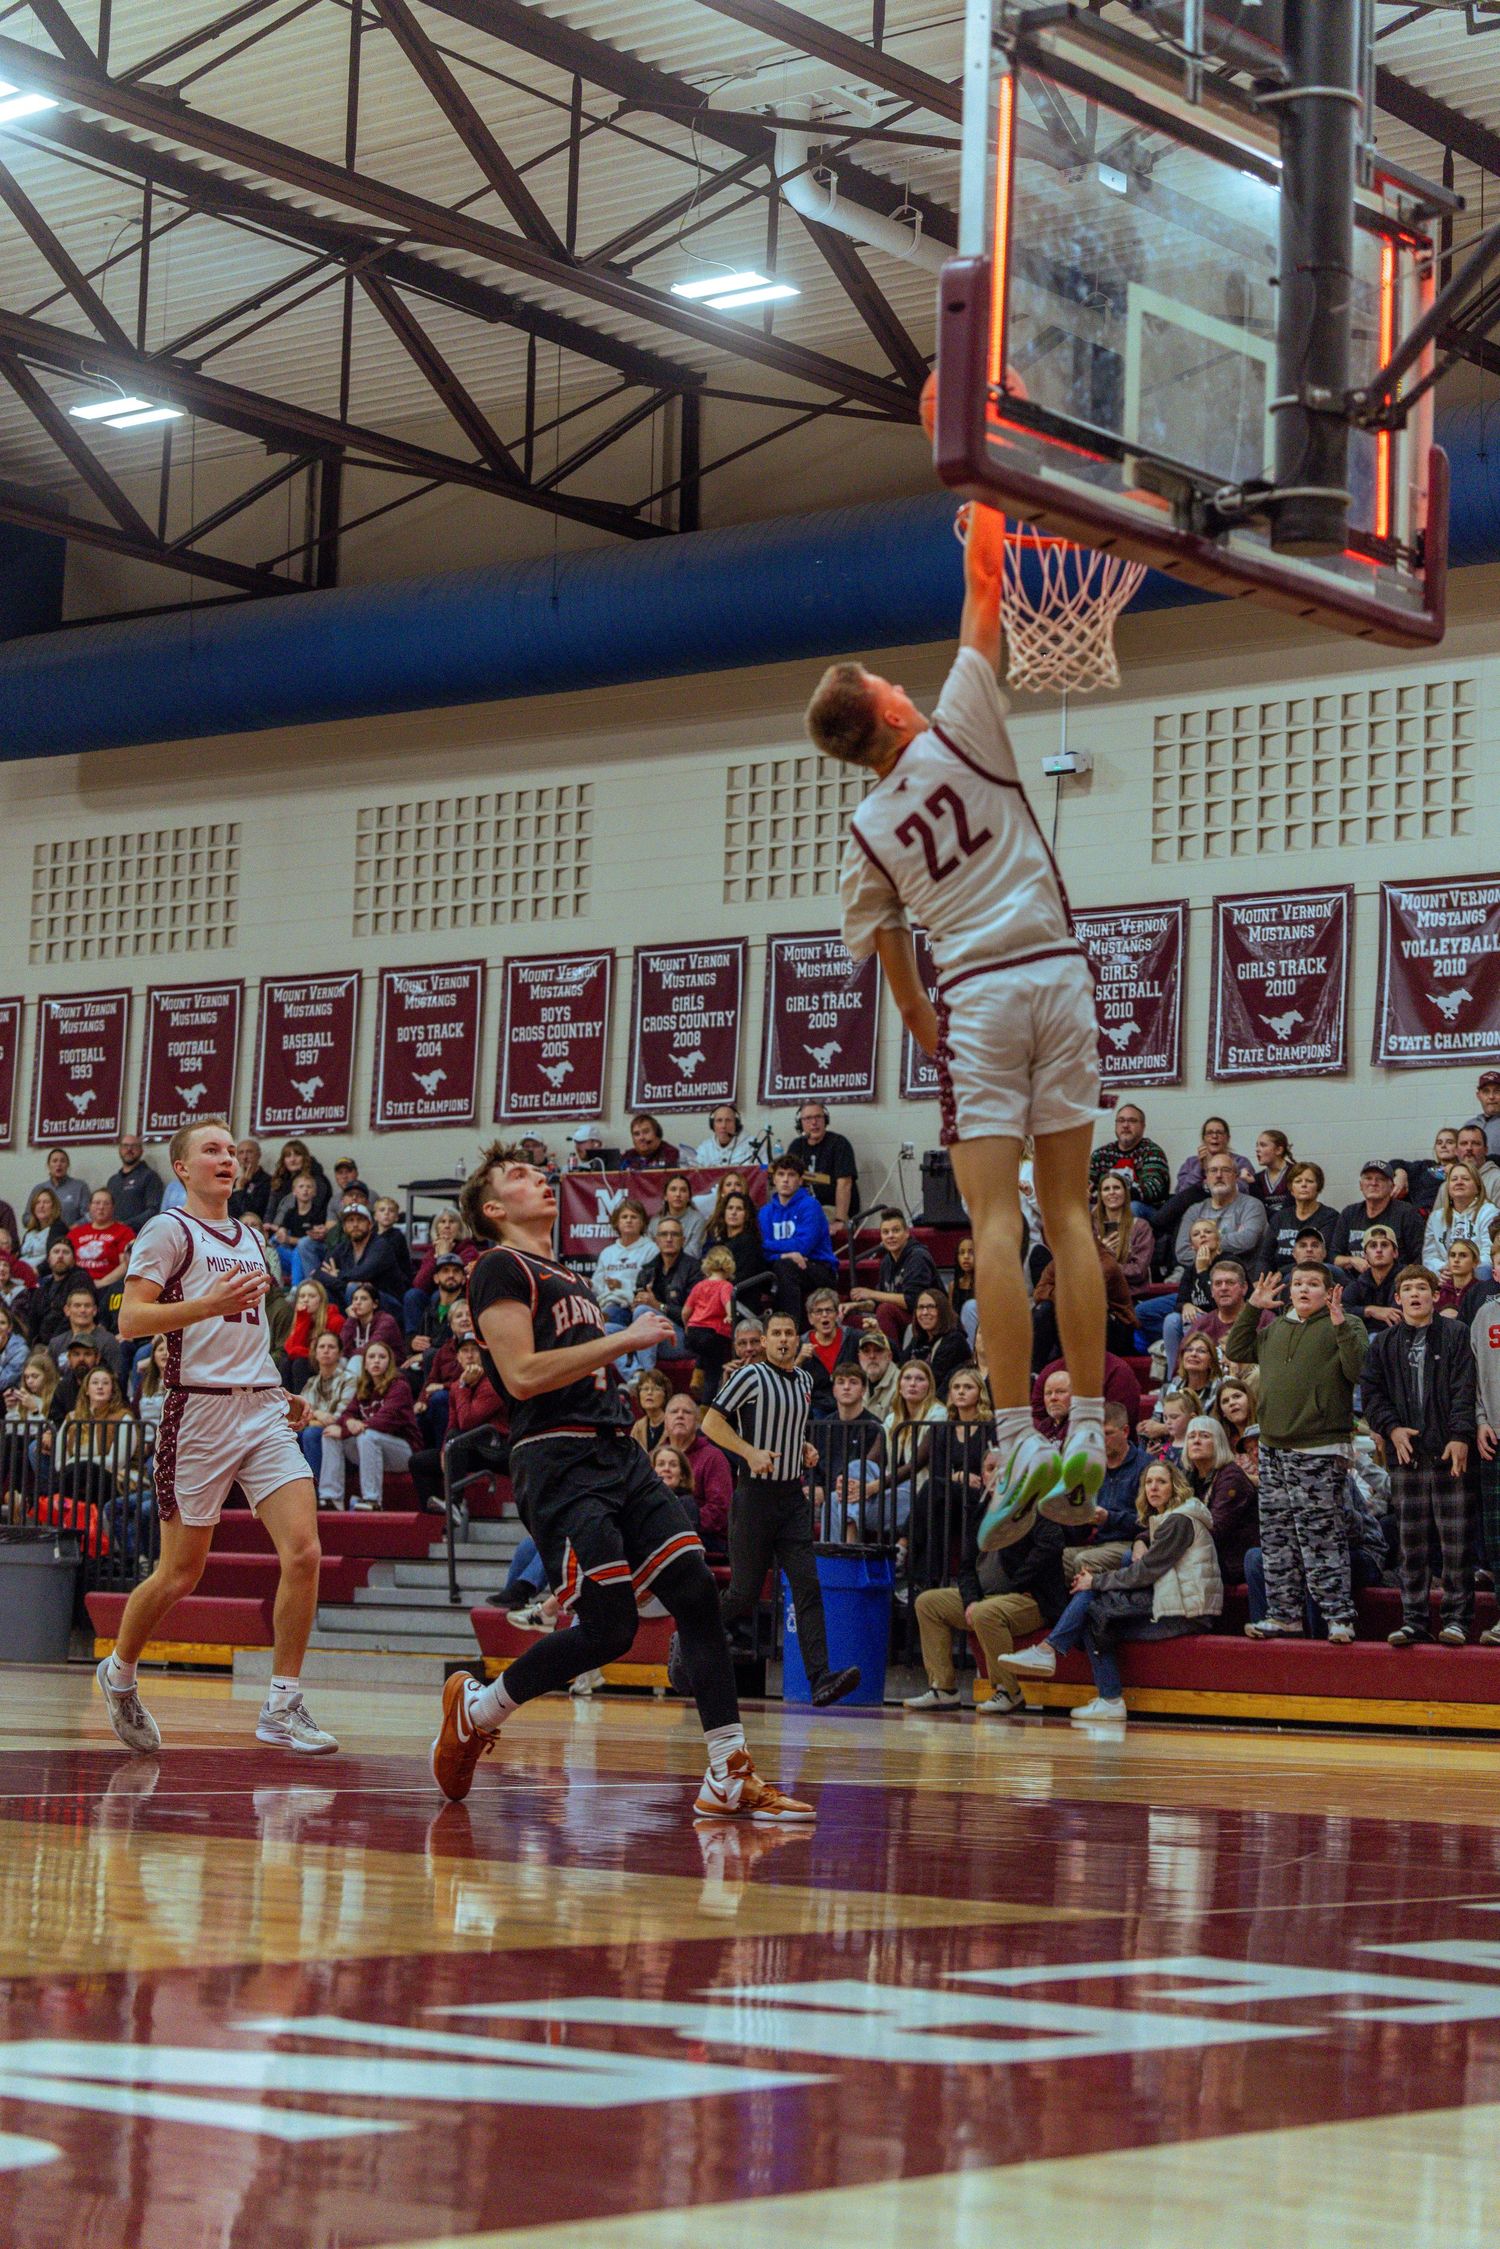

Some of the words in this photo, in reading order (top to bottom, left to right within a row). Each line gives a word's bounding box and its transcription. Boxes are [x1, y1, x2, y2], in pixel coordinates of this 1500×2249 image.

[895, 784, 993, 882] 22
[1400, 893, 1448, 910] MOUNT
[1233, 908, 1276, 925] MOUNT
[1282, 903, 1332, 920] VERNON
[1417, 909, 1487, 928] MUSTANGS
[1075, 921, 1119, 938] MOUNT
[1120, 918, 1168, 934] VERNON
[1249, 925, 1315, 942] MUSTANGS
[784, 945, 821, 961] MOUNT
[1089, 939, 1151, 956] MUSTANGS
[1401, 933, 1500, 959] VOLLEYBALL
[649, 957, 686, 973] MOUNT
[689, 954, 730, 970] VERNON
[796, 961, 853, 978] MUSTANGS
[1238, 961, 1275, 980] GIRLS
[1279, 957, 1327, 976] TRACK
[1433, 958, 1467, 977] 2010
[518, 968, 554, 984] MOUNT
[662, 973, 716, 989] MUSTANGS
[1101, 963, 1138, 982] GIRLS
[394, 978, 427, 993] MOUNT
[431, 975, 470, 990] VERNON
[530, 984, 583, 1000] MUSTANGS
[1096, 981, 1162, 1000] SKETBALL
[1265, 979, 1296, 997] 2010
[273, 988, 306, 1002] MOUNT
[310, 985, 346, 999] VERNON
[404, 994, 457, 1010] MUSTANGS
[786, 995, 819, 1012] GIRLS
[822, 992, 862, 1010] TRACK
[51, 1004, 82, 1019] MOUNT
[84, 1003, 117, 1017] VERNON
[160, 996, 191, 1011] MOUNT
[195, 994, 229, 1008] VERNON
[284, 1003, 332, 1018] MUSTANGS
[672, 995, 704, 1012] GIRLS
[1104, 1002, 1133, 1019] 2010
[170, 1012, 217, 1026] MUSTANGS
[541, 1006, 571, 1023] BOYS
[643, 1015, 676, 1032] CROSS
[679, 1011, 735, 1030] COUNTRY
[808, 1012, 838, 1029] 2009
[60, 1020, 105, 1034] MUSTANGS
[397, 1025, 425, 1042] BOYS
[427, 1022, 464, 1039] TRACK
[512, 1026, 544, 1042] CROSS
[547, 1021, 602, 1039] COUNTRY
[168, 1039, 216, 1057] FOOTBALL
[282, 1032, 334, 1049] BASEBALL
[673, 1031, 701, 1048] 2008
[1388, 1034, 1431, 1051] STATE
[59, 1047, 106, 1064] FOOTBALL
[295, 1050, 319, 1065] 1997
[416, 1041, 442, 1057] 2004
[541, 1041, 569, 1057] 2005
[1228, 1046, 1264, 1063] STATE
[1267, 1043, 1332, 1061] CHAMPIONS
[179, 1057, 202, 1072] 1994
[1105, 1055, 1167, 1071] CHAMPIONS
[70, 1064, 93, 1080] 1993
[919, 1066, 939, 1082] STA
[775, 1074, 806, 1090] STATE
[809, 1072, 868, 1088] CHAMPIONS
[644, 1083, 672, 1099] STATE
[675, 1081, 728, 1097] CHAMPIONS
[386, 1101, 415, 1115] STATE
[417, 1098, 469, 1113] CHAMPIONS
[511, 1093, 540, 1108] STATE
[543, 1091, 597, 1107] CHAMPIONS
[151, 1113, 177, 1127] STATE
[265, 1107, 293, 1122] STATE
[295, 1105, 344, 1120] CHAMPIONS
[42, 1119, 66, 1133] STATE
[68, 1117, 115, 1131] CHAMPIONS
